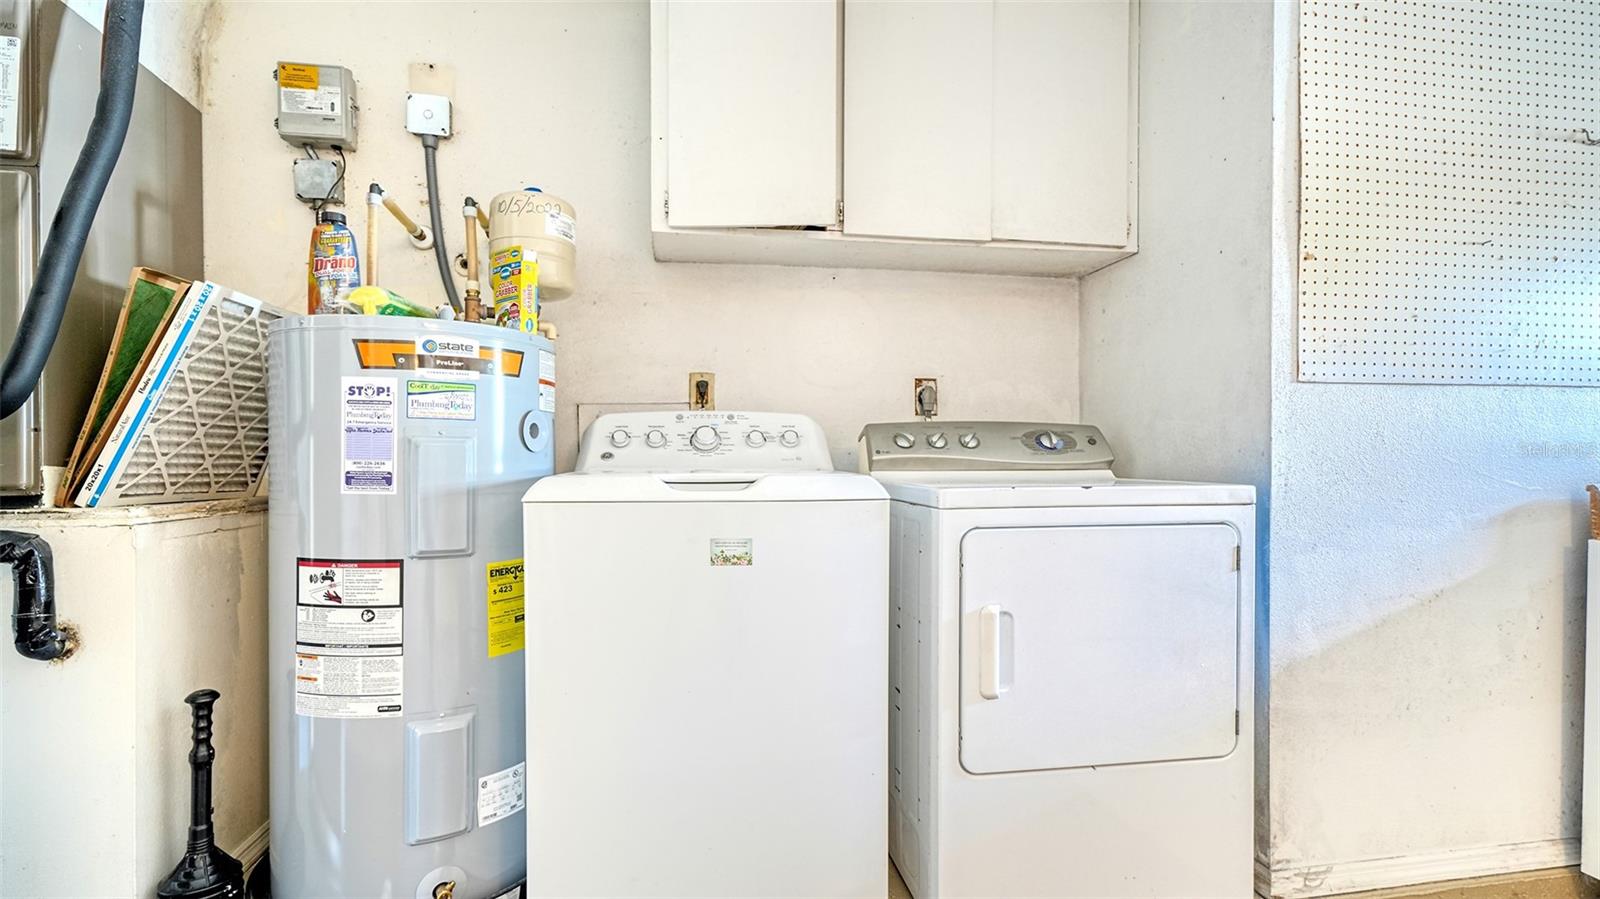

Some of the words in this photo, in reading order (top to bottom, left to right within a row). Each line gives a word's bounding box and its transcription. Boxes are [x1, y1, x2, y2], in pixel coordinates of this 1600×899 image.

[438, 342, 475, 353] state
[347, 384, 392, 398] STOP!
[85, 464, 104, 492] 20x20x1
[498, 584, 514, 594] 423
